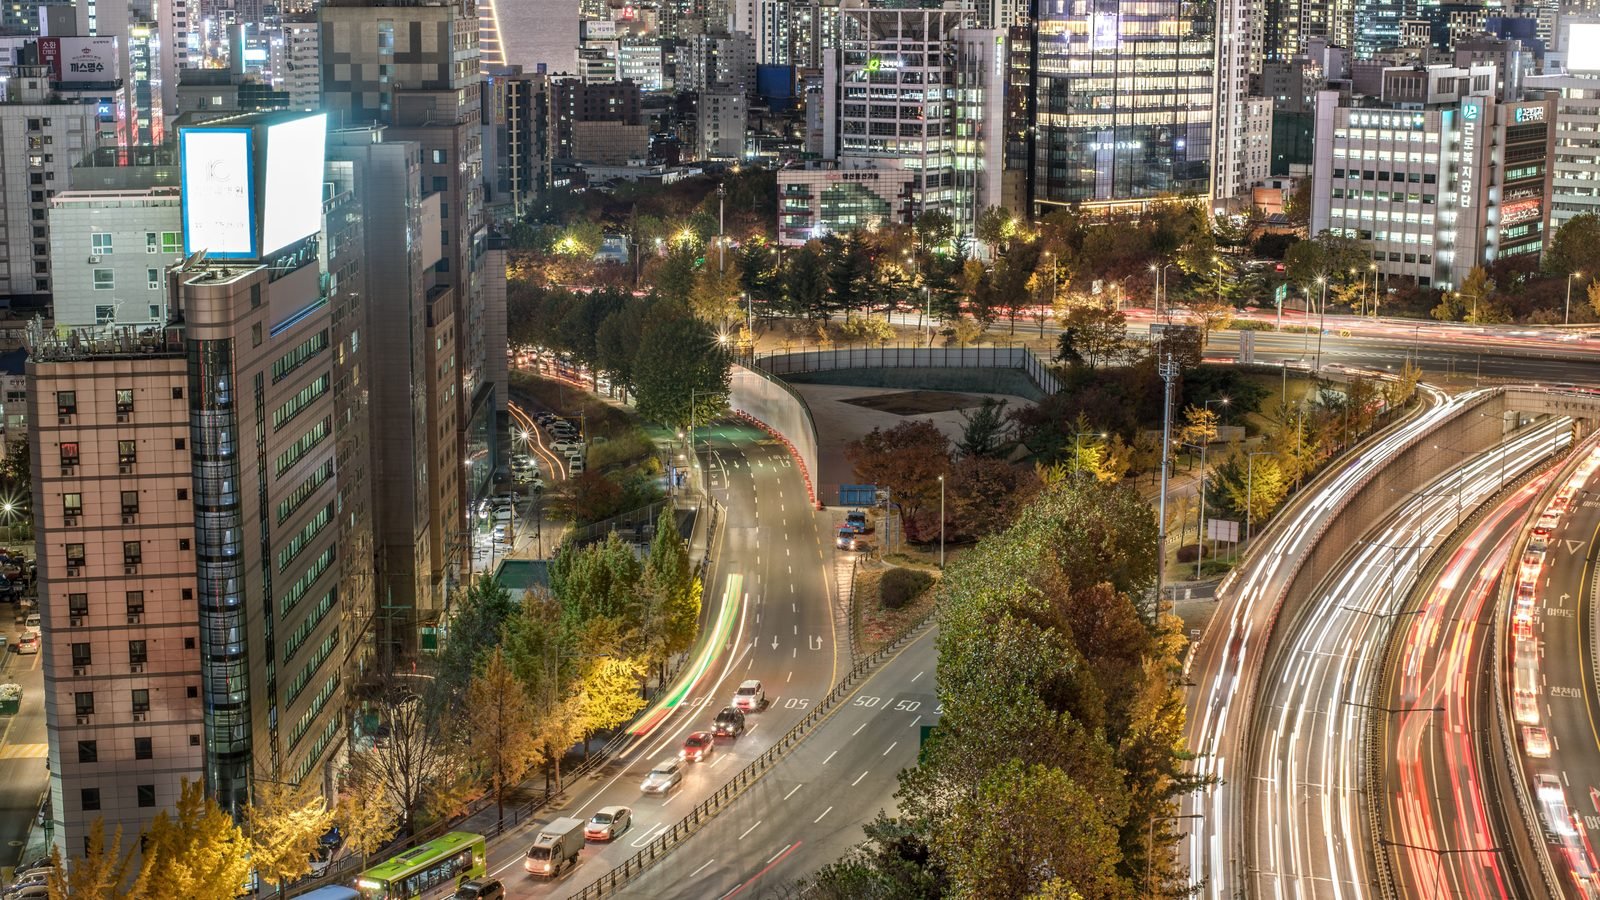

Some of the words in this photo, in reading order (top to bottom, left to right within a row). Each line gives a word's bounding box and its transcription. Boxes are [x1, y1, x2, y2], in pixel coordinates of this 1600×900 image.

[70, 62, 104, 72] 까스명수
[1461, 122, 1474, 207] 근로복지공단
[1547, 607, 1575, 617] 여의도
[853, 696, 880, 708] 50
[894, 700, 921, 712] 50
